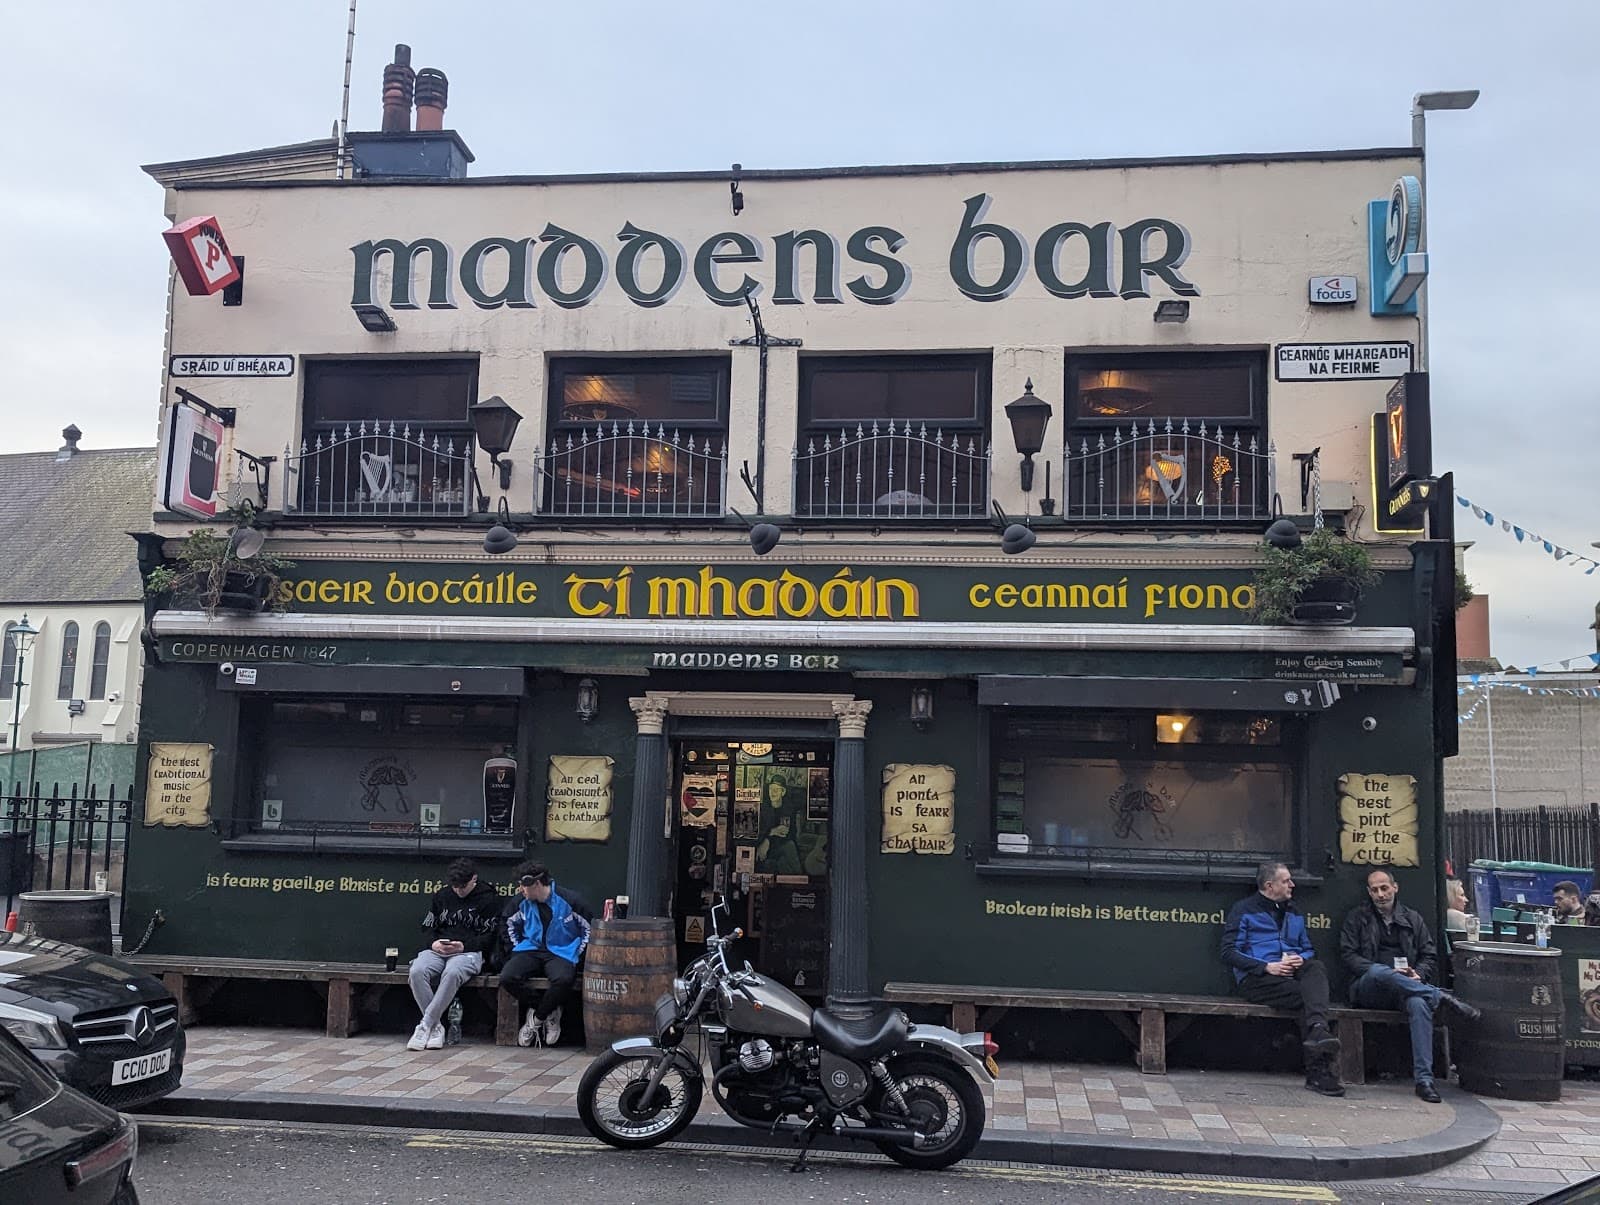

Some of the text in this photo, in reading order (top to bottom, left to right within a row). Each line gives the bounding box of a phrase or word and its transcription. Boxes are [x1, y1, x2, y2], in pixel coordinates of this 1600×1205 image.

[1317, 288, 1351, 300] focus
[1280, 347, 1409, 361] CEARNÓG MHARGADH
[180, 358, 286, 372] SRÁID UÍ BHÉARA
[1309, 361, 1381, 375] NA FEIRME
[267, 580, 376, 605] saeir
[172, 642, 337, 660] COPENHAGEN 1847
[1275, 655, 1384, 671] Enjoy Carlsberg Sensibly
[163, 780, 191, 791] music
[1364, 778, 1389, 792] the
[161, 793, 192, 803] in the
[1359, 812, 1391, 829] pint
[1352, 829, 1400, 844] in the
[206, 872, 220, 887] is
[272, 875, 335, 893] gaeilge
[399, 879, 420, 894] ná
[985, 900, 1048, 917] Broken
[1095, 905, 1111, 920] is
[1114, 905, 1168, 922] Better
[1171, 908, 1208, 925] than
[121, 1053, 166, 1080] CC10 DOC
